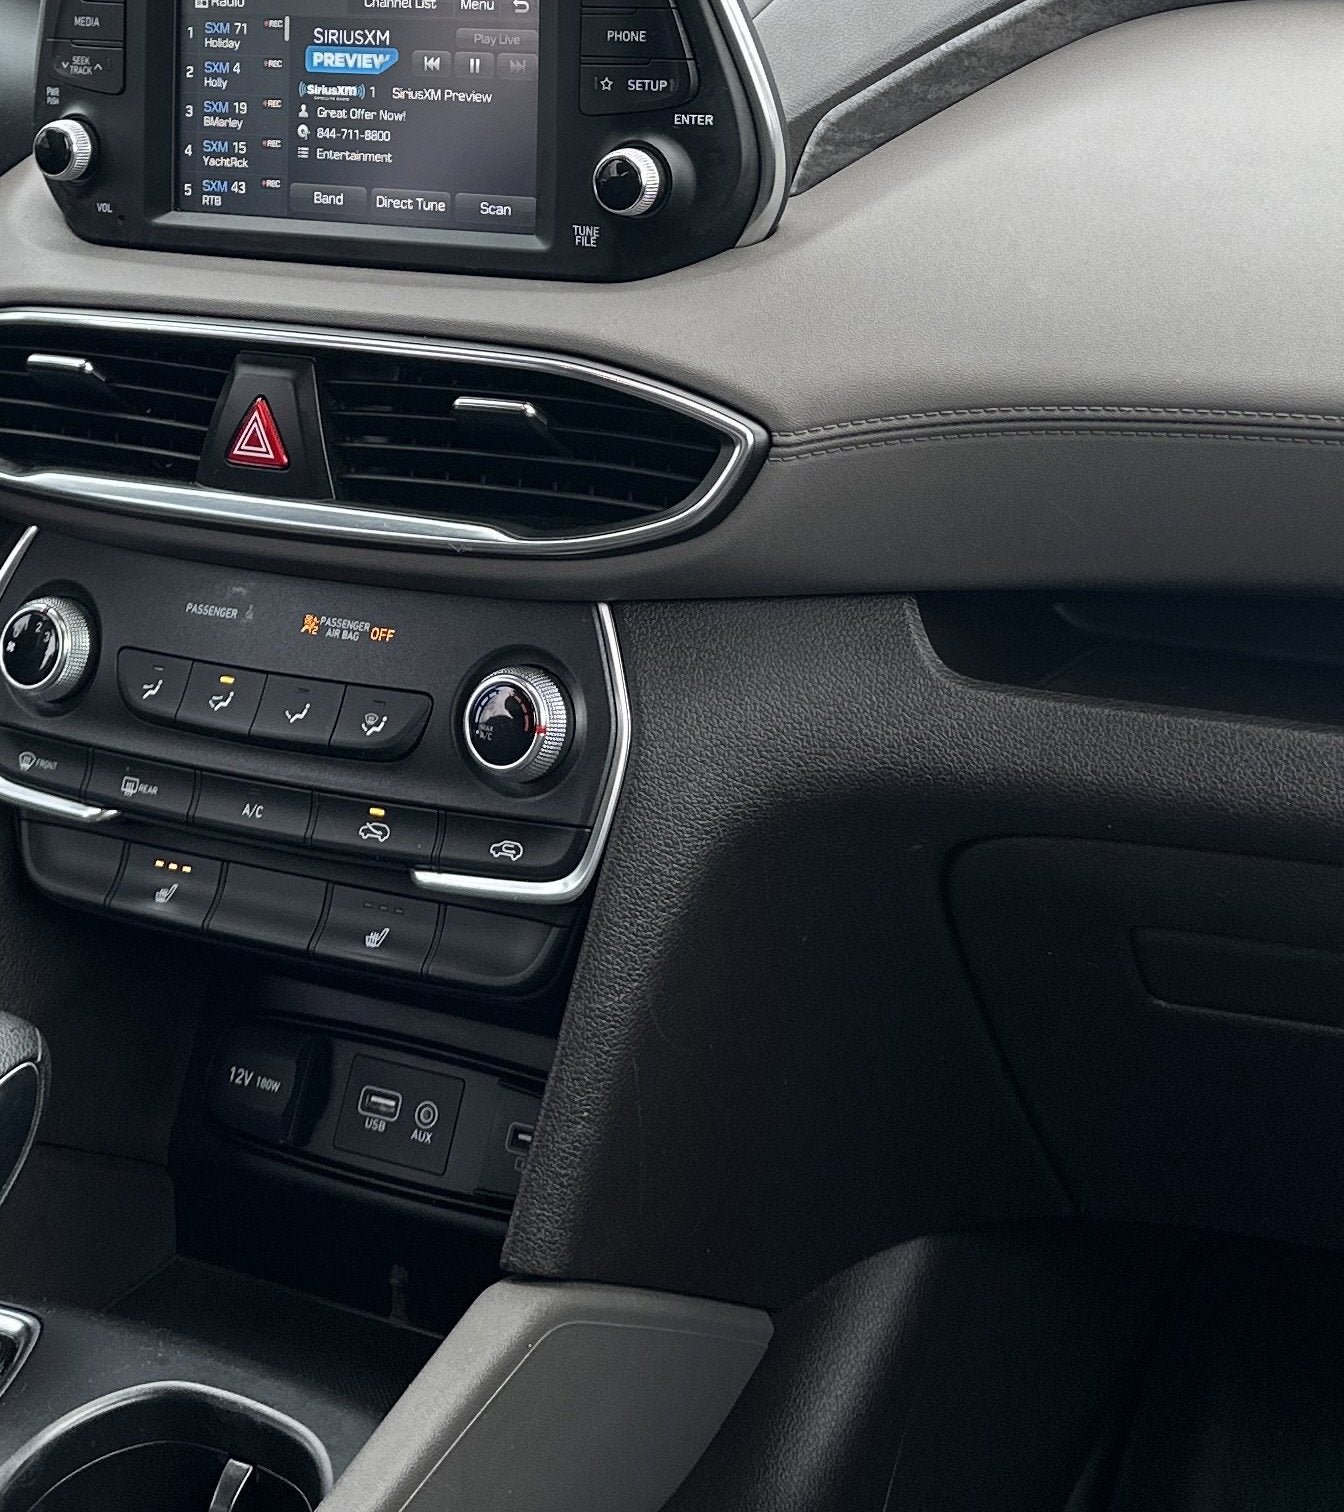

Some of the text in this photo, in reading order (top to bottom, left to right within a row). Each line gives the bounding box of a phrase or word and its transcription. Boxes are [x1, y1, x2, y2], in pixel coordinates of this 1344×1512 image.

[73, 16, 100, 28] MEDIA
[204, 22, 248, 35] SXM 71
[187, 26, 194, 38] 1
[313, 27, 390, 46] SIRIUSXM
[607, 30, 647, 43] PHONE
[204, 37, 241, 51] Holiday
[473, 33, 521, 47] Play Live
[72, 55, 91, 66] SEEK
[312, 51, 391, 69] PREVIEW
[70, 65, 93, 76] TRACK
[185, 66, 194, 78] 2
[204, 61, 241, 74] SXM 4
[204, 76, 228, 90] Holly
[627, 79, 668, 92] SETUP
[369, 86, 376, 98] 1
[392, 87, 442, 102] SiriusXM
[444, 89, 493, 104] Preview
[185, 105, 194, 117] 3
[203, 100, 248, 114] SXM 19
[316, 107, 406, 122] Great Offer Now!
[673, 114, 714, 127] ENTER
[316, 128, 391, 142] 844-711-8800
[184, 144, 193, 157] 4
[202, 140, 247, 154] SXM 15
[202, 155, 249, 168] YachtRck
[316, 148, 393, 163] Entertainment
[184, 183, 192, 196] 5
[202, 179, 246, 194] SXM 43
[202, 195, 222, 206] RTB
[313, 191, 344, 205] Band
[376, 195, 446, 212] Direct Tune
[96, 202, 112, 214] VOL
[480, 201, 512, 216] Scan
[572, 224, 600, 238] TUNE
[575, 236, 597, 248] FILE
[185, 602, 238, 619] PASSENGER
[35, 622, 44, 633] 2
[319, 615, 371, 632] PASSENGER
[325, 628, 360, 642] AIR BAG
[370, 626, 396, 642] OFF
[35, 757, 58, 771] FRONT
[139, 782, 159, 795] REAR
[242, 803, 264, 819] A/C
[229, 1066, 255, 1087] 12V
[364, 1117, 387, 1133] USB
[410, 1128, 433, 1144] AUX
